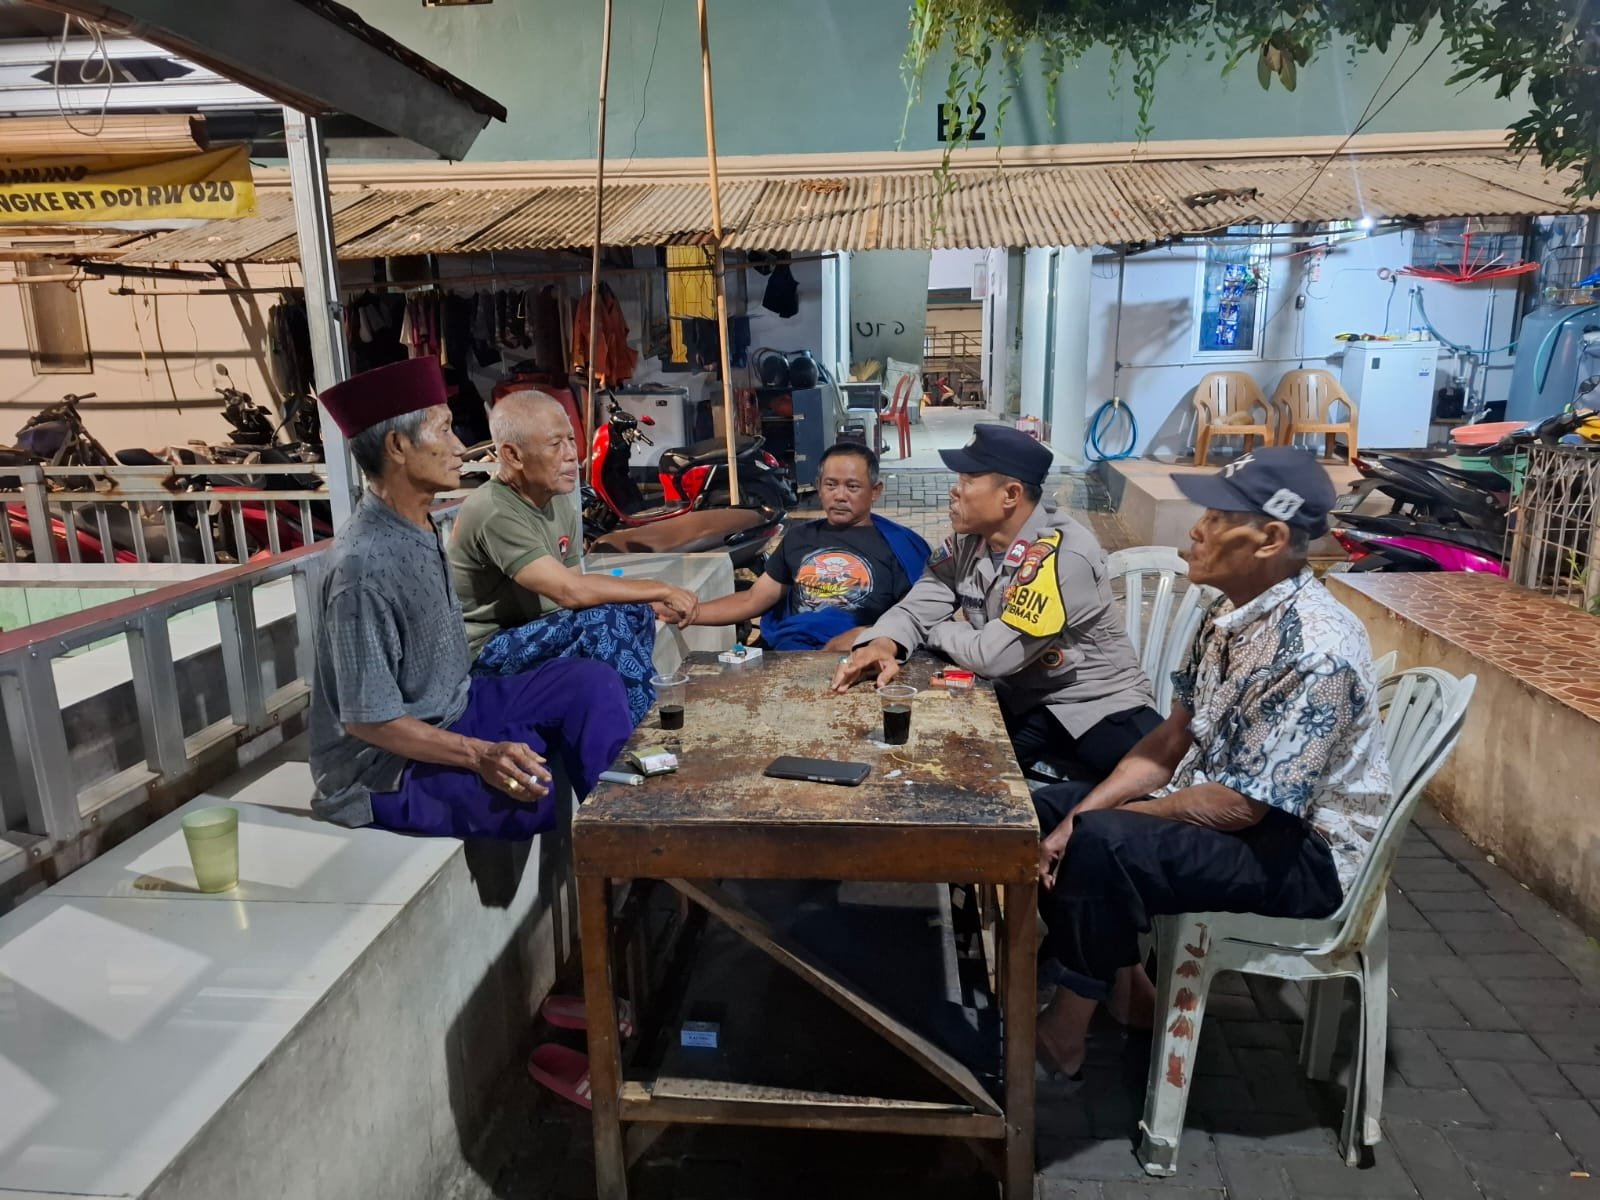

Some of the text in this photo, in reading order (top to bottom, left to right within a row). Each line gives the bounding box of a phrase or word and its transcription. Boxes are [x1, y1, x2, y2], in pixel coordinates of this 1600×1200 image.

[937, 102, 986, 142] B2
[62, 190, 96, 210] RT
[147, 184, 185, 206] RW
[189, 180, 235, 203] 020
